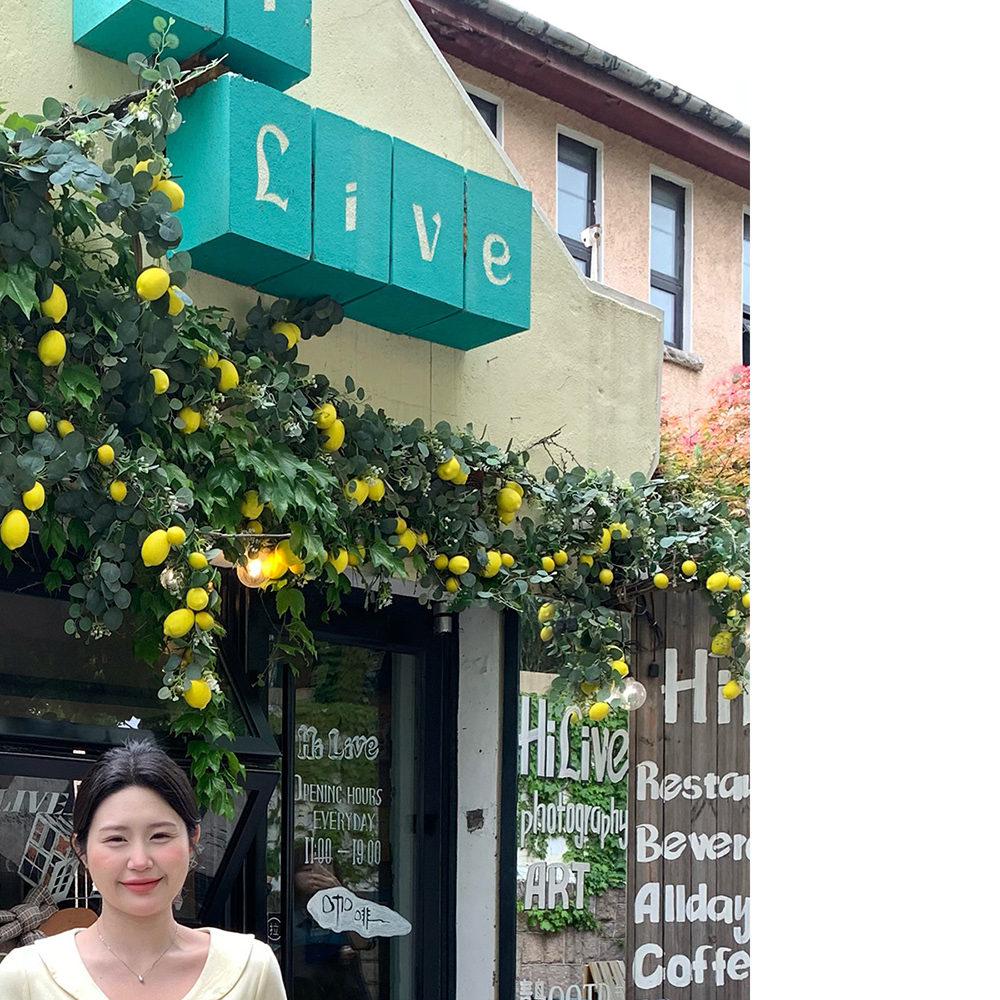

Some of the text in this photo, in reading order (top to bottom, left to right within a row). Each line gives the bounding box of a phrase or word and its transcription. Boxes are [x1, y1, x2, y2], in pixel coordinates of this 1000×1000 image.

[255, 124, 511, 286] Live
[327, 728, 380, 761] Live
[347, 786, 383, 806] HOURS
[520, 789, 628, 850] photography
[636, 823, 750, 863] Bever
[524, 861, 591, 910] ART
[634, 881, 750, 945] Allday
